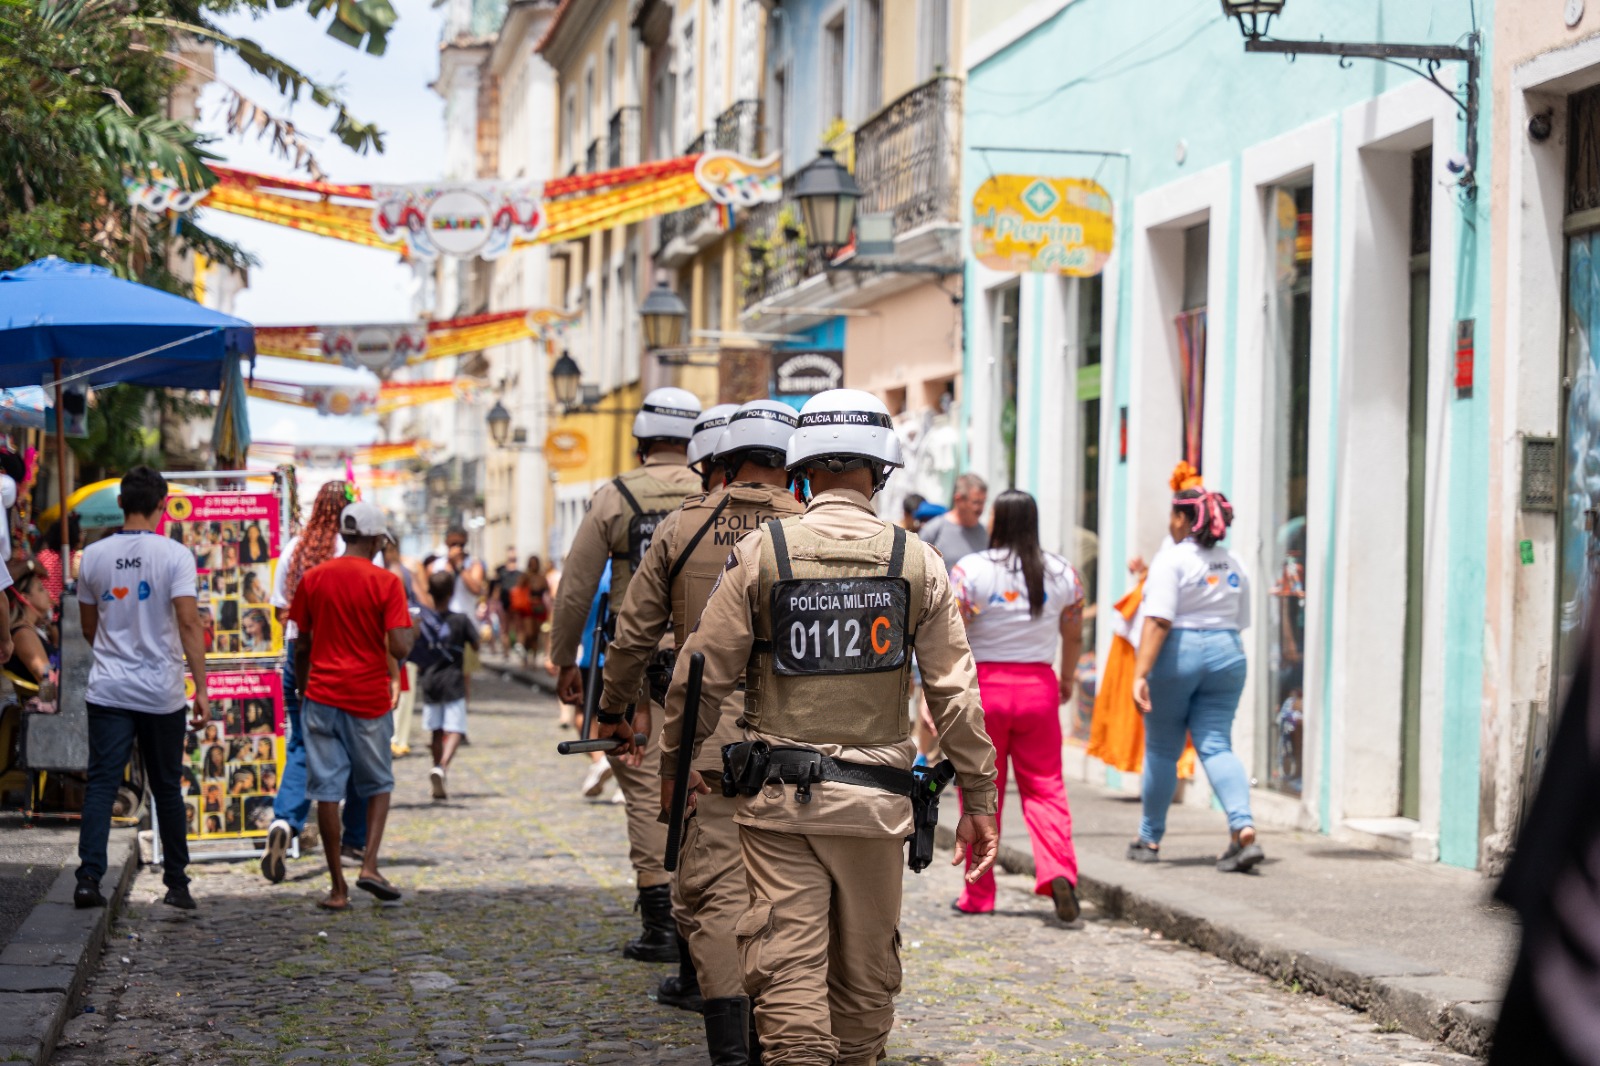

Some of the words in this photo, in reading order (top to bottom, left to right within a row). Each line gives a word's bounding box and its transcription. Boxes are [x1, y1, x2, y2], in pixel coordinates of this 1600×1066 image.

[778, 413, 798, 428] MILIT
[802, 412, 831, 424] POLÍCIA
[833, 413, 869, 423] MILITAR
[115, 556, 142, 570] SMS
[790, 592, 841, 611] POLÍCIA
[843, 592, 892, 609] MILITAR
[790, 618, 861, 660] 0112
[870, 616, 891, 655] C
